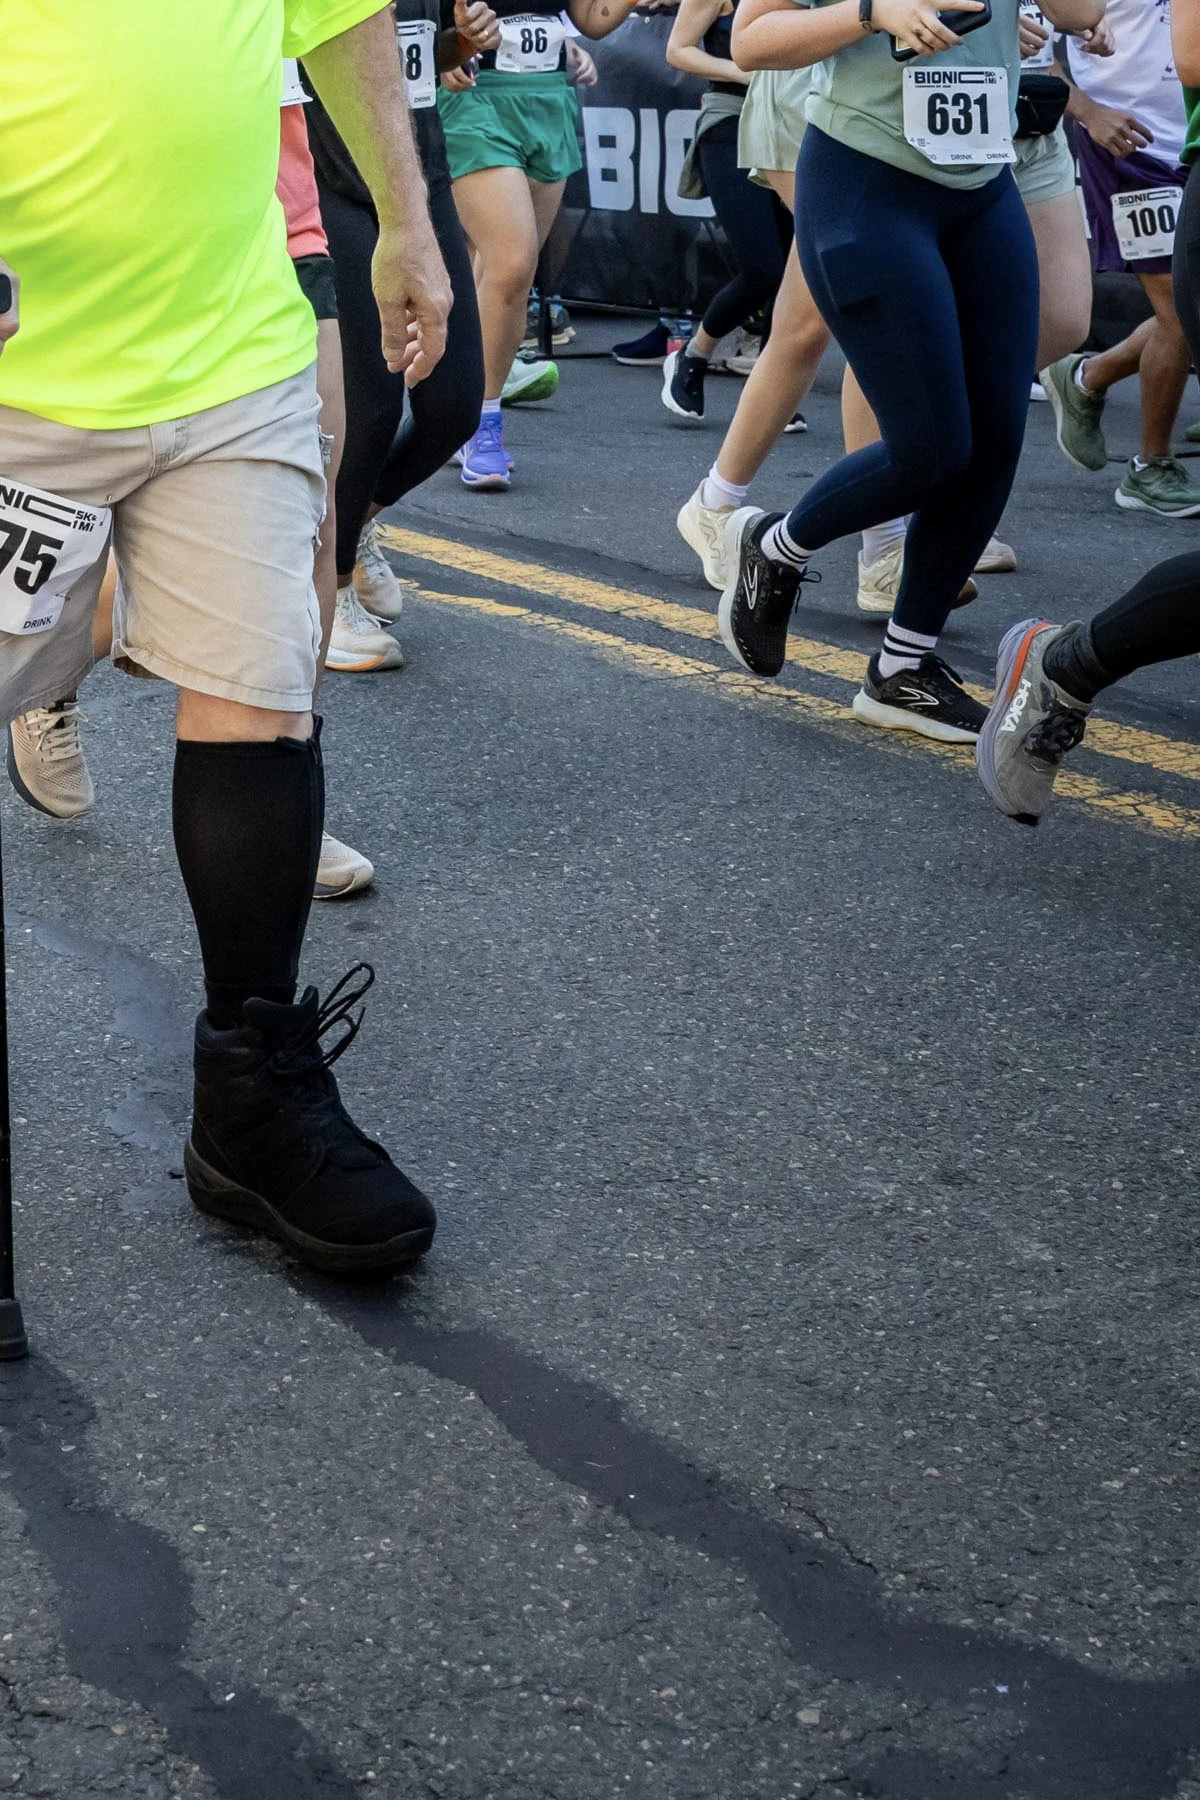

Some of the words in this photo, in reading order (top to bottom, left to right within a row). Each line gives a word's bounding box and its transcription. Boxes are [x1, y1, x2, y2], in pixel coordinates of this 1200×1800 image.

[502, 14, 554, 25] BIONIC
[520, 27, 548, 54] 86
[400, 43, 422, 81] 8
[914, 71, 984, 84] BIONIC
[414, 96, 431, 104] DRINK
[927, 92, 989, 136] 631
[1118, 190, 1170, 205] BIONIC
[1126, 204, 1175, 238] 100
[22, 615, 54, 630] DRINK
[1001, 678, 1032, 733] HOKA
